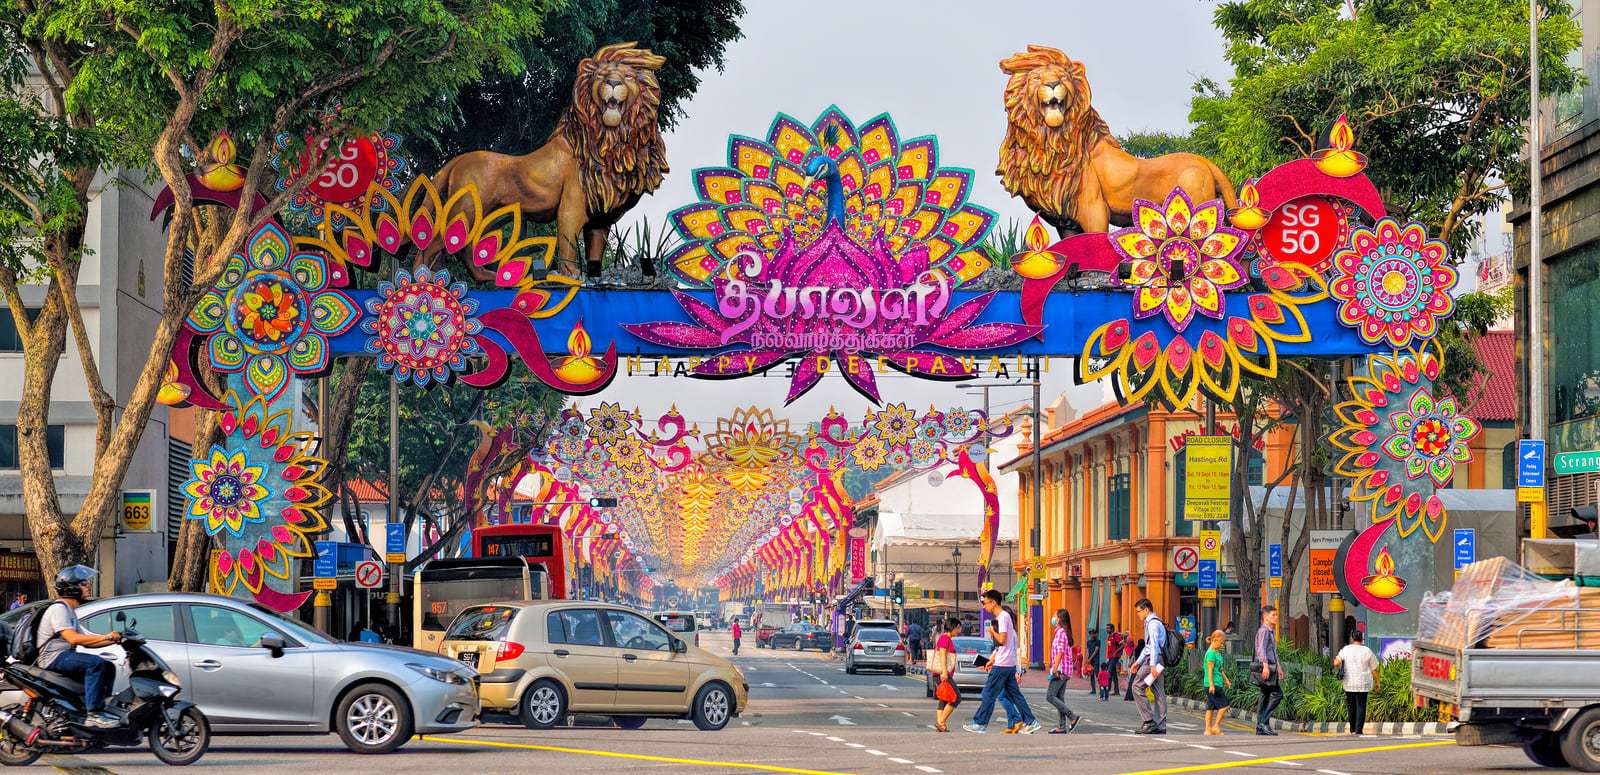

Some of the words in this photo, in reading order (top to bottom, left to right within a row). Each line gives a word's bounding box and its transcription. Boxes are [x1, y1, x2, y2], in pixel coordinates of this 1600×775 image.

[319, 163, 358, 188] 50
[1281, 204, 1319, 227] SG
[1281, 229, 1319, 254] 50
[626, 354, 758, 374] HAPPY
[816, 352, 1049, 374] DEEPAVALI
[1186, 436, 1203, 444] ROAD
[1204, 436, 1231, 444] CLOSURE
[1189, 456, 1217, 464] Hastings
[124, 506, 149, 519] 663
[487, 543, 500, 556] 147
[1312, 577, 1324, 585] 21st
[1325, 577, 1334, 587] Ap
[431, 602, 448, 615] 857
